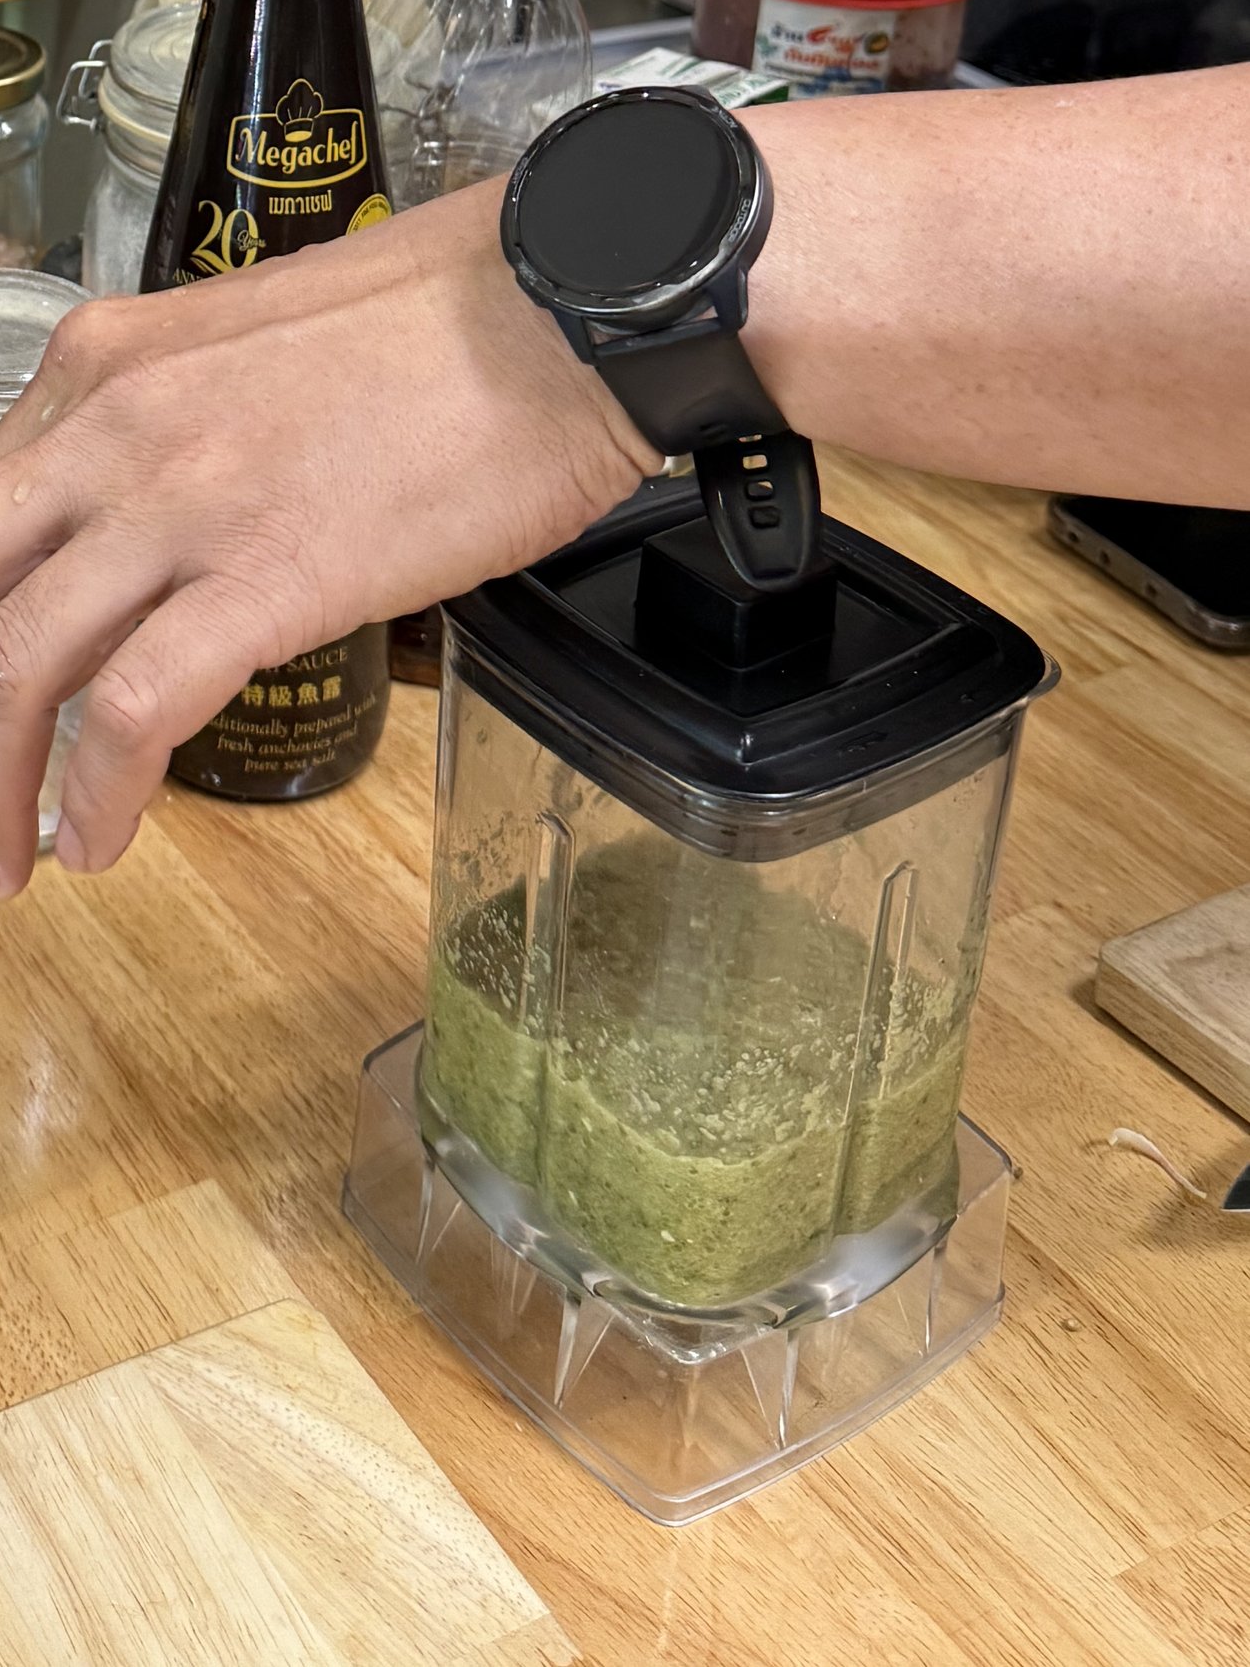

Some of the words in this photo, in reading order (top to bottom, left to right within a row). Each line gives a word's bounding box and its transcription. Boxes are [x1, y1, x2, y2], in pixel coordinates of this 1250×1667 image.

[235, 120, 359, 174] Megachef
[269, 190, 332, 214] เมกาเชฟ
[191, 200, 259, 273] 20
[287, 646, 349, 672] SAUCE
[294, 703, 351, 738] prepared
[217, 733, 254, 754] fresh
[258, 736, 332, 755] anchovies
[244, 757, 279, 773] pure
